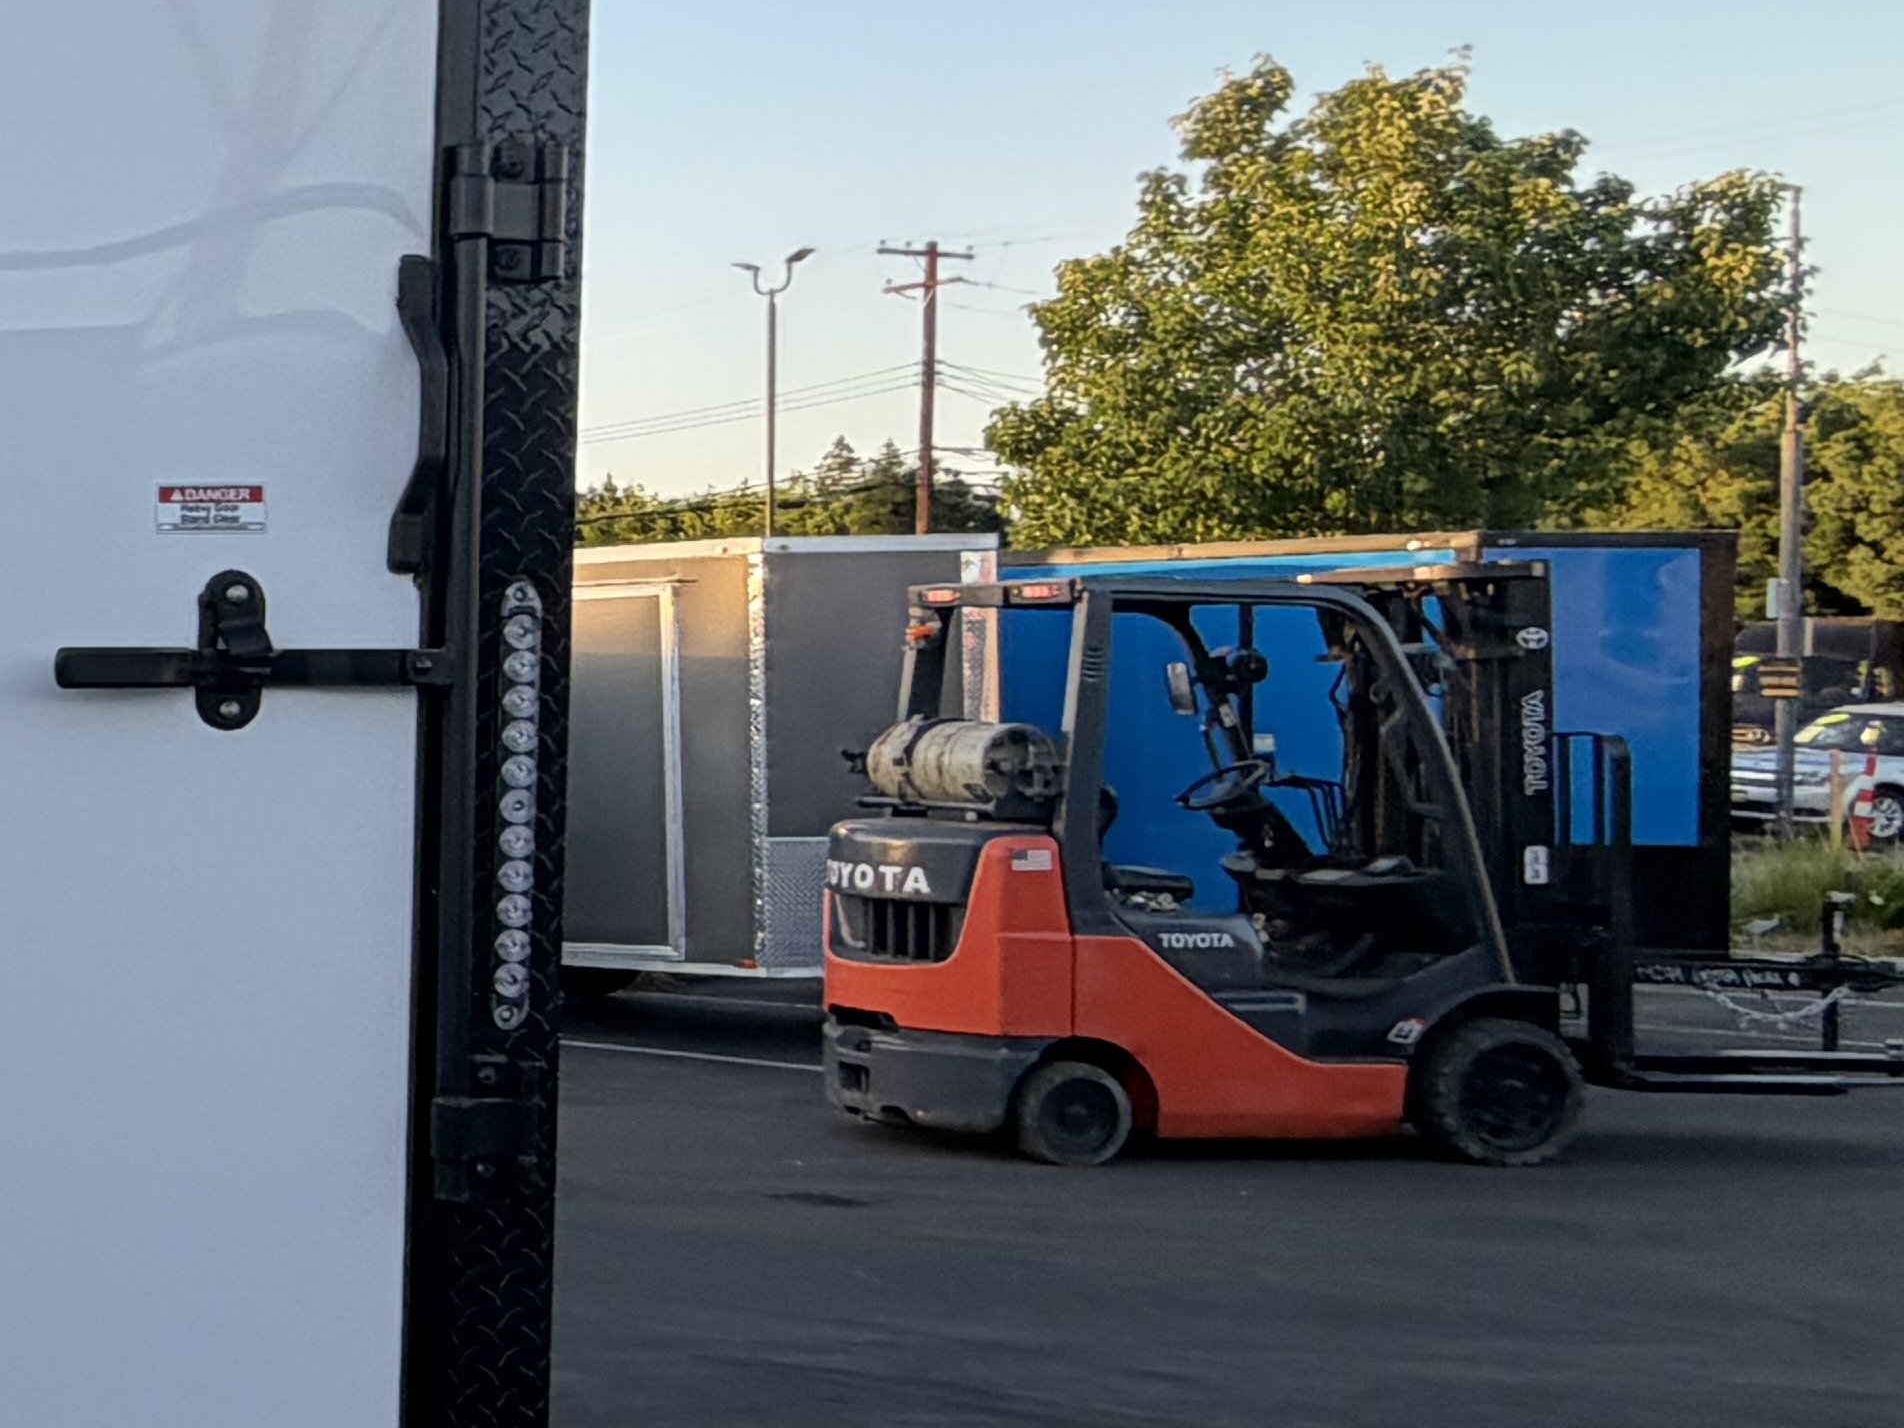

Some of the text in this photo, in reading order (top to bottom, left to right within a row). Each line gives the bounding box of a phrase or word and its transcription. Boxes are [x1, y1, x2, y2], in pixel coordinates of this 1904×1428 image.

[184, 488, 250, 500] DANGER
[1520, 688, 1548, 796] TOYOTA
[1157, 932, 1234, 949] TOYOTA
